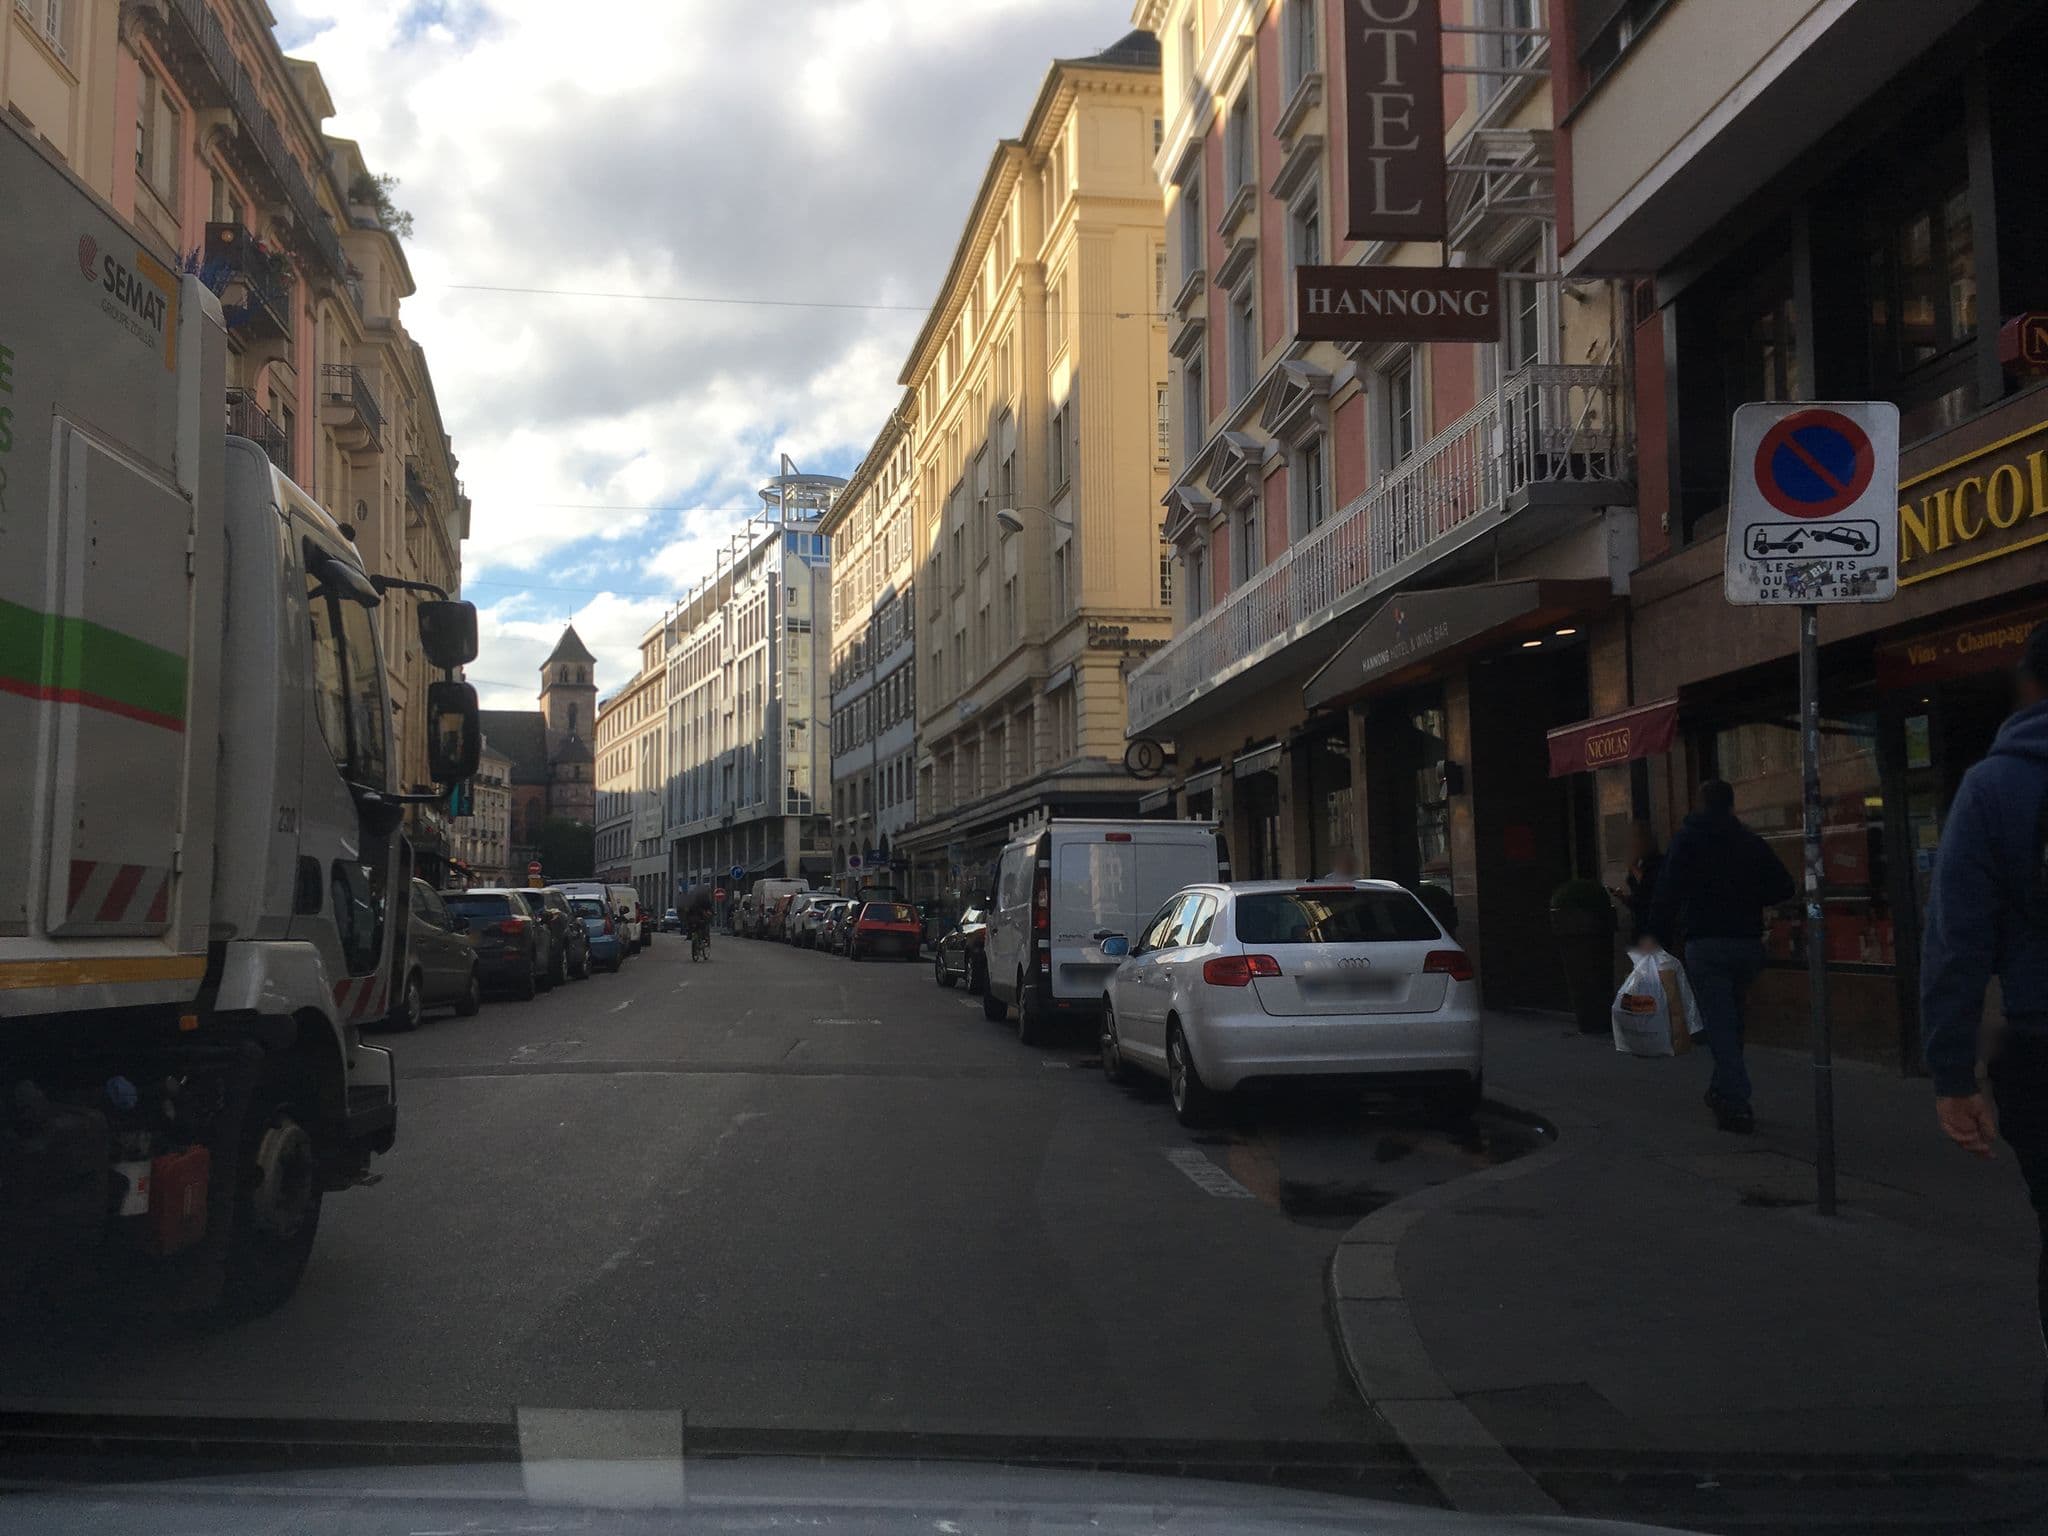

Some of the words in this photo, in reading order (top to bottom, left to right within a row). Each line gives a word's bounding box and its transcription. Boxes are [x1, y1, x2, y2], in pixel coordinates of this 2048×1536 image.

[103, 254, 166, 332] SEMAT
[1306, 288, 1490, 317] HANNONG
[1766, 562, 1794, 573] LES
[1761, 588, 1779, 599] DE
[1087, 621, 1130, 635] Home
[1587, 733, 1628, 759] NICOLAS
